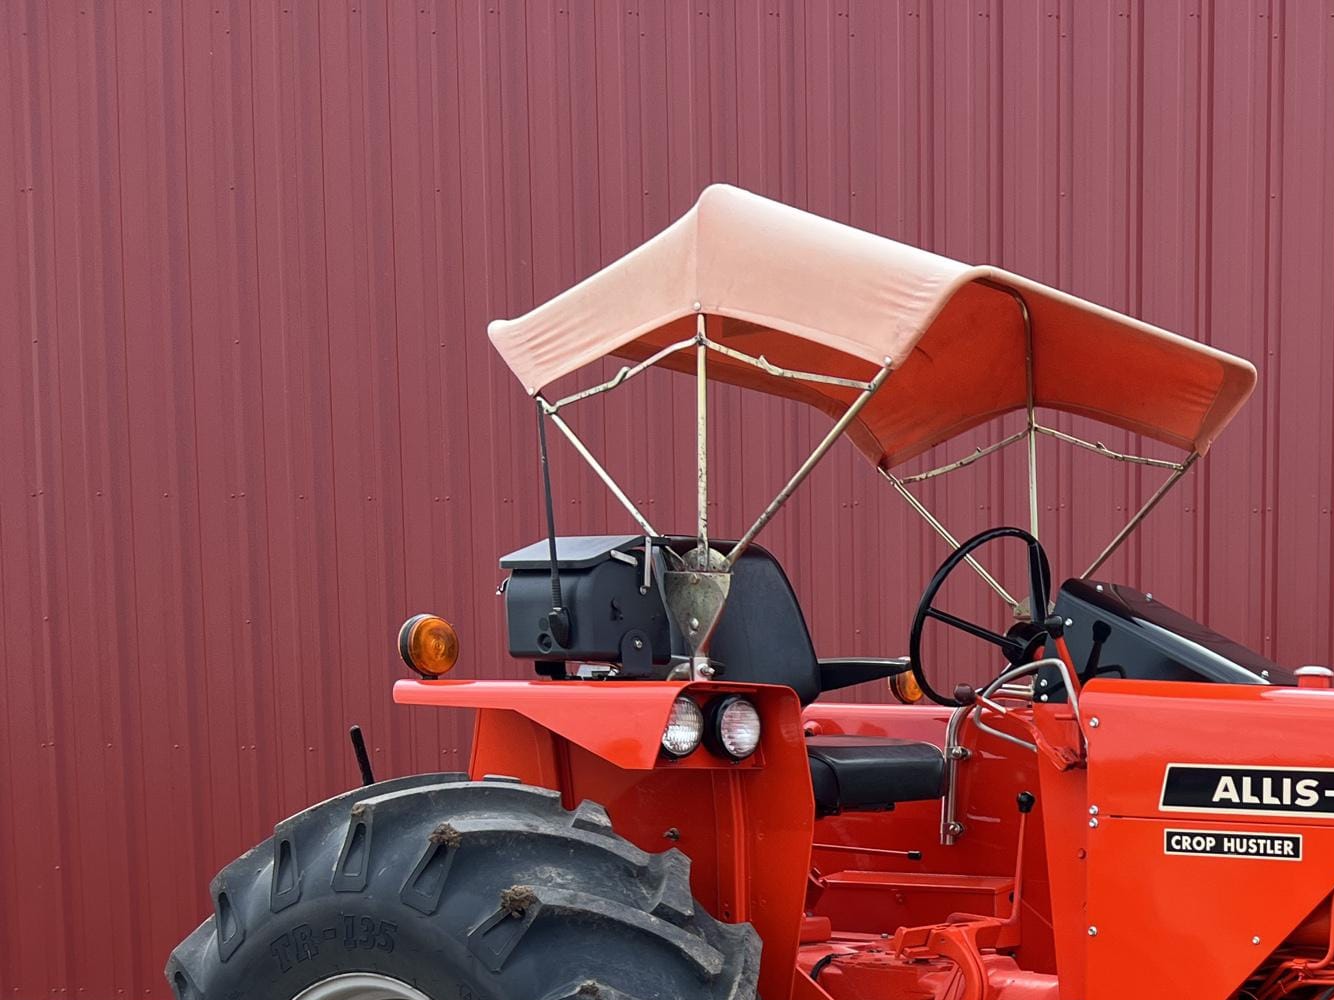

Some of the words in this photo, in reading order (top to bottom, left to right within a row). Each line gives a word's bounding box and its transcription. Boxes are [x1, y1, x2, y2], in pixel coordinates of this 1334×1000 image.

[1171, 835, 1216, 851] CROP
[1223, 837, 1294, 856] HUSTLER
[269, 914, 399, 974] TR-135
